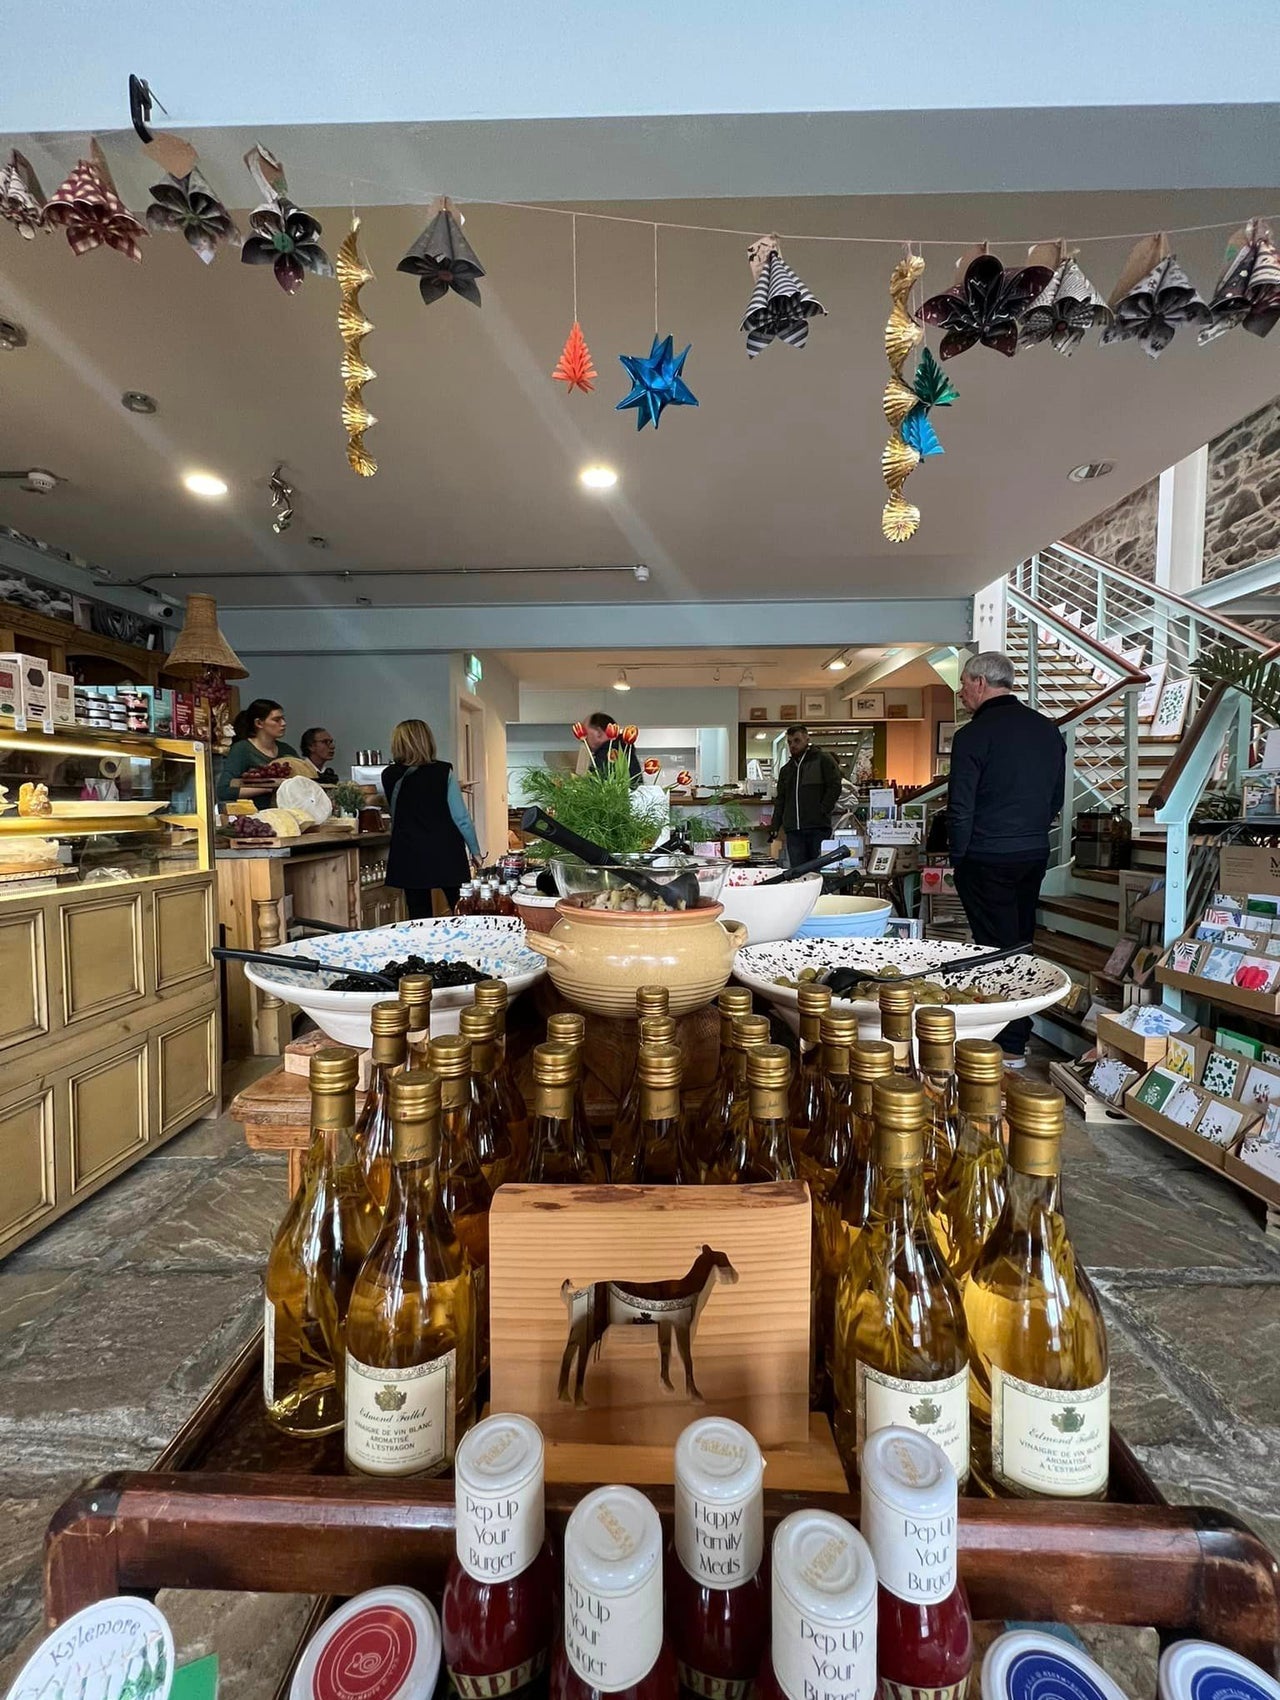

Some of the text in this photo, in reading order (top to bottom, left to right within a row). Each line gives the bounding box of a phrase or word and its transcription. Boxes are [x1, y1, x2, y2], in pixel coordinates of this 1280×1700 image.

[393, 1427, 407, 1436] VIN
[408, 1420, 432, 1434] BLANC
[1028, 1427, 1074, 1445] Edmond
[371, 1443, 415, 1452] L'ESTRAGON
[1019, 1439, 1057, 1457] VINAIGRE
[465, 1496, 519, 1525] Pep Up
[694, 1501, 743, 1530] Happy
[473, 1524, 511, 1546] Your
[695, 1526, 743, 1551] Family
[904, 1519, 937, 1545] Pep
[469, 1546, 517, 1575] Burger
[699, 1552, 741, 1575] Meals
[915, 1545, 950, 1567] Your
[908, 1566, 953, 1594] Burger
[588, 1596, 611, 1624] Up
[569, 1603, 601, 1646] Your
[801, 1618, 864, 1656] Pep Up
[50, 1618, 141, 1667] Kylemore
[812, 1655, 855, 1681] Your
